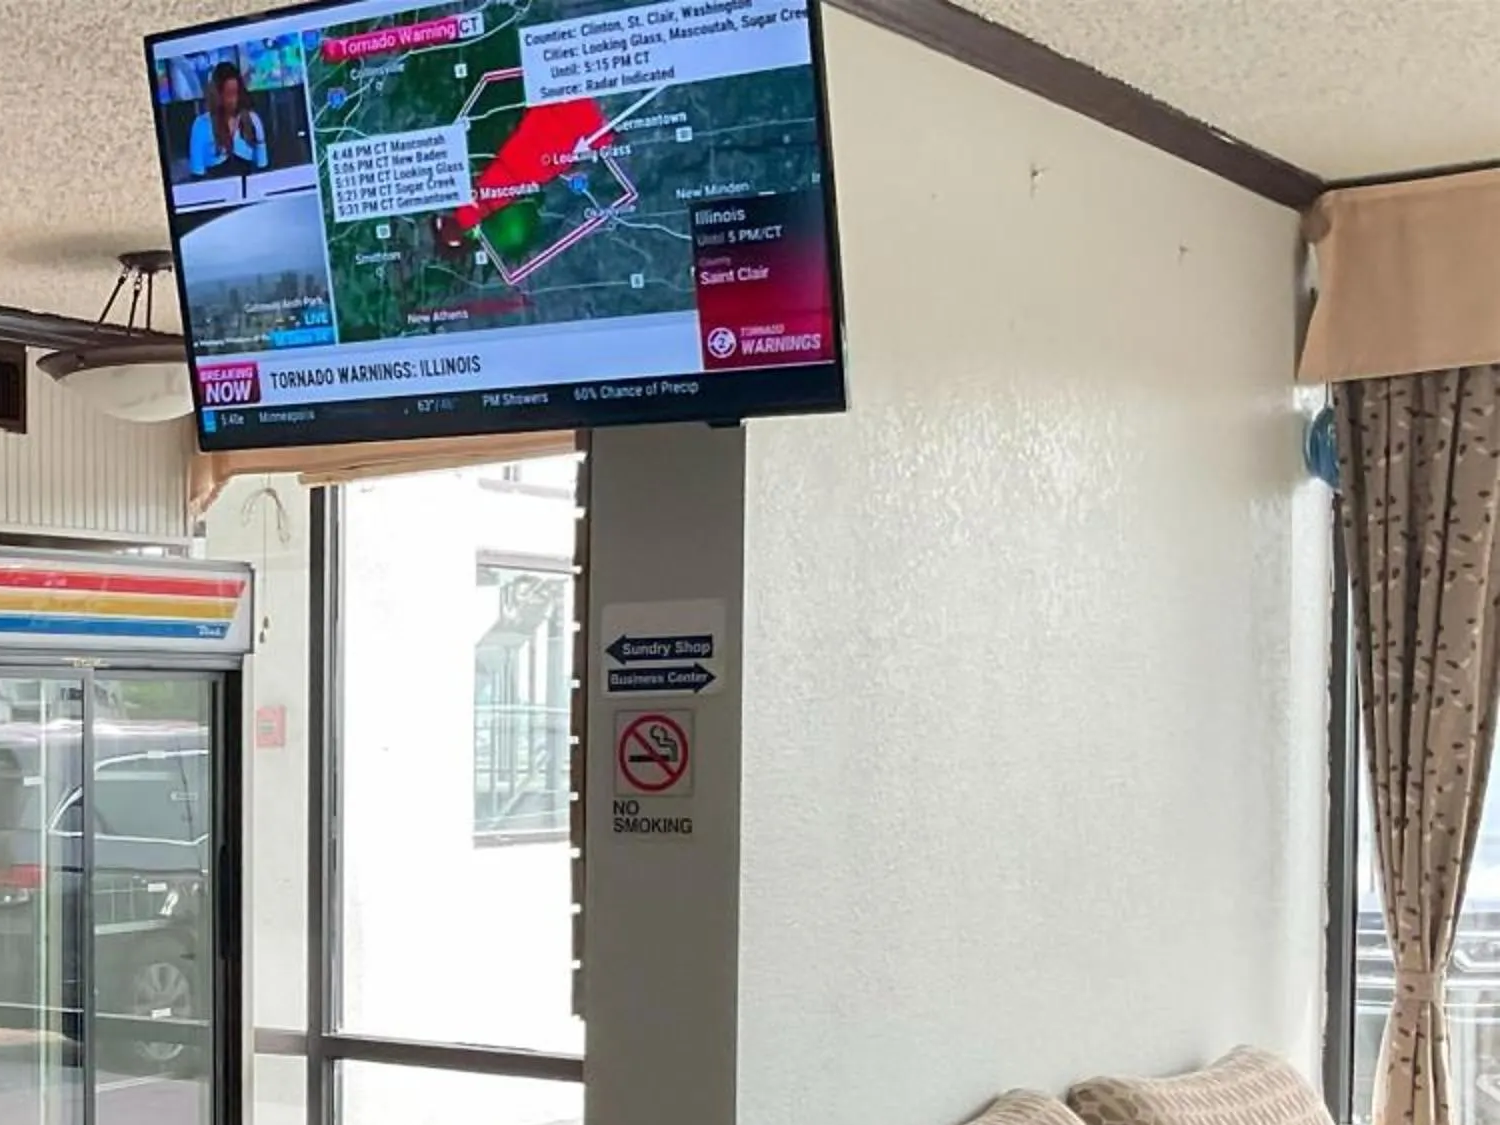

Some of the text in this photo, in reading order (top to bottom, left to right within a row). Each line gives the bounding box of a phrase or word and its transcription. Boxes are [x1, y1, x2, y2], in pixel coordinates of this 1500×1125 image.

[459, 17, 478, 34] CT
[582, 39, 627, 55] Looking
[741, 12, 777, 29] Sugar
[340, 22, 456, 56] Tornado Warning
[525, 29, 576, 46] Counties:
[584, 58, 609, 73] 5:15
[612, 54, 631, 69] PM
[634, 51, 649, 65] CT
[585, 76, 618, 91] Radar
[621, 65, 675, 86] Indicated
[356, 145, 372, 157] PM
[374, 142, 387, 155] CT
[357, 159, 373, 171] PM
[375, 156, 389, 168] CT
[392, 154, 414, 165] New
[416, 149, 448, 162] Baden
[359, 173, 375, 184] PM
[377, 170, 390, 182] CT
[393, 166, 434, 182] Looking
[436, 161, 465, 174] Glass
[361, 187, 376, 199] PM
[379, 184, 392, 196] CT
[395, 180, 425, 197] Sugar
[427, 176, 456, 190] Creek
[480, 182, 540, 200] Mascoutah
[675, 181, 749, 200] New Minden
[361, 201, 378, 213] PM
[381, 199, 393, 211] CT
[695, 208, 746, 226] Illinois
[727, 230, 736, 244] 5
[738, 225, 783, 241] PM/CT
[700, 264, 770, 286] Saint Clair
[741, 333, 821, 356] WARNINGS
[200, 367, 253, 382] BREAKING
[270, 355, 481, 389] TORNADO WARNINGS: ILLINOIS
[205, 379, 252, 404] NOW
[484, 394, 499, 407] PM
[502, 392, 549, 406] Showers
[600, 384, 642, 399] Chance
[645, 381, 658, 396] of
[661, 380, 699, 395] Precip
[622, 640, 710, 657] Sundry Shop
[611, 670, 709, 685] Business Center
[613, 800, 640, 815] NO
[613, 818, 693, 834] SMOKING
